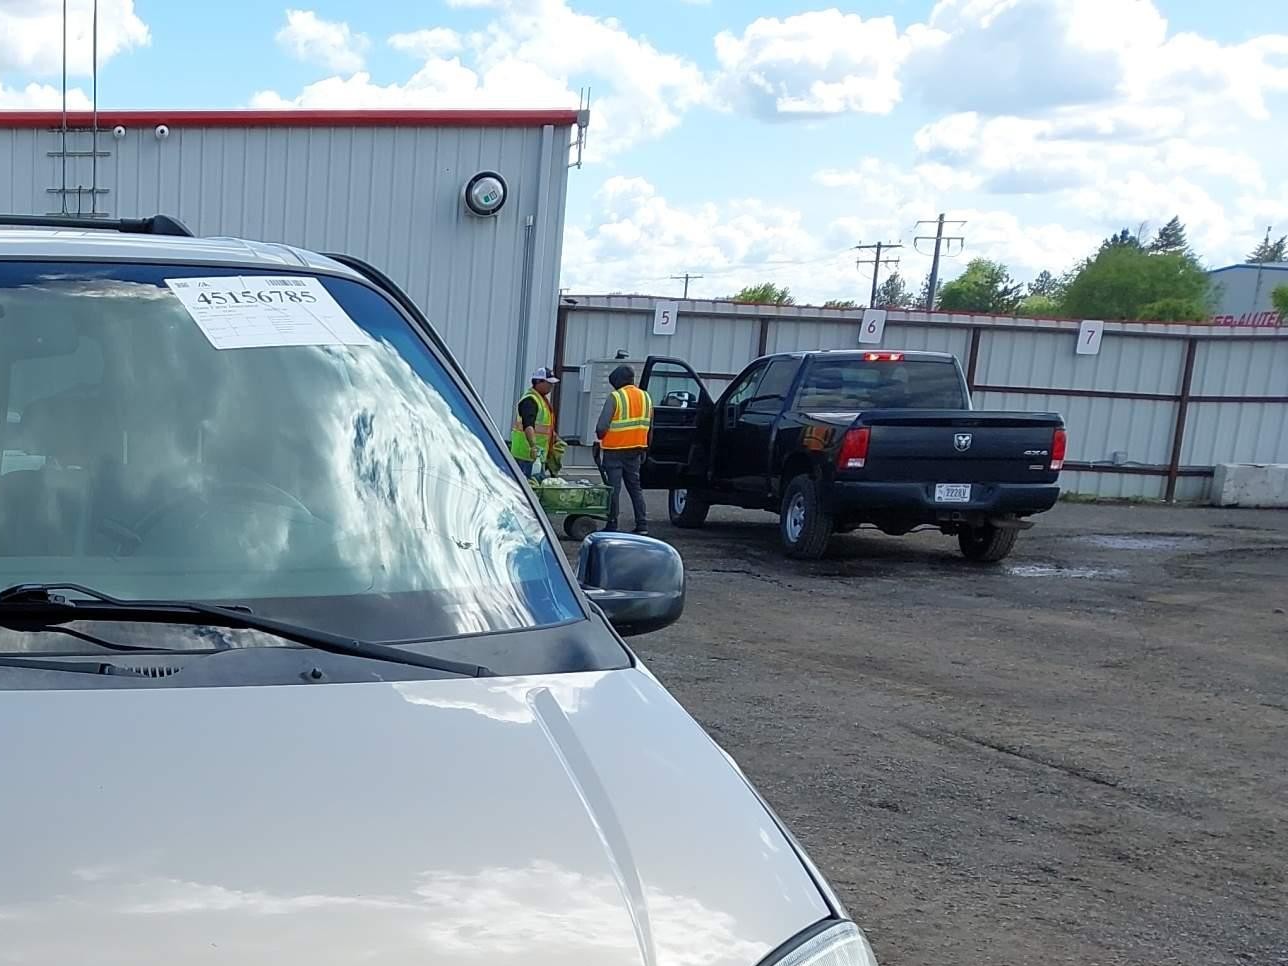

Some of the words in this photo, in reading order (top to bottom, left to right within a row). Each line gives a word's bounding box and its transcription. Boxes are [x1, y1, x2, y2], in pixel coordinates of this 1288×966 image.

[197, 290, 317, 305] 45156785
[661, 310, 670, 325] 5
[867, 319, 877, 334] 6
[1086, 330, 1096, 345] 7
